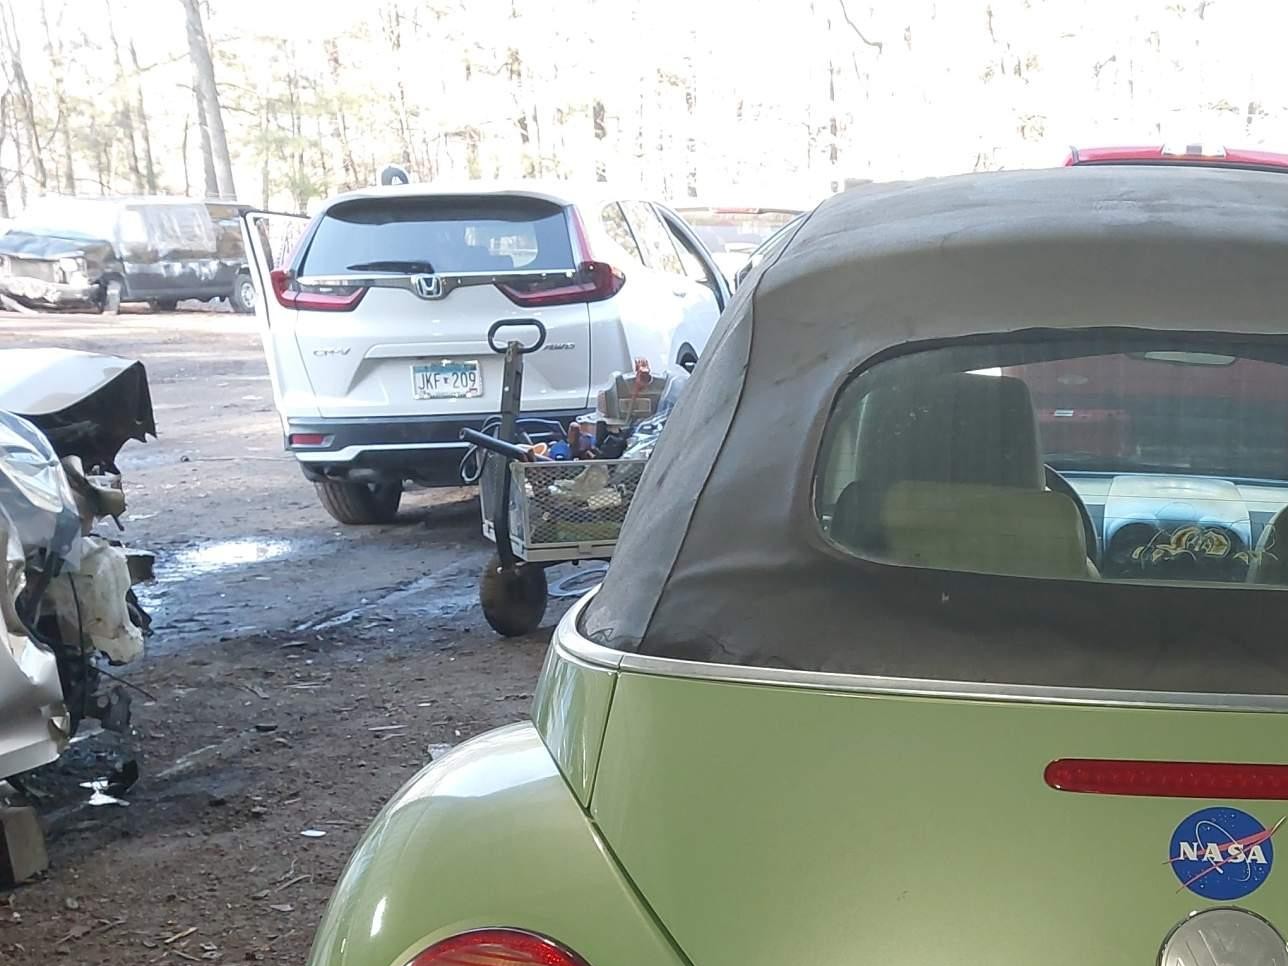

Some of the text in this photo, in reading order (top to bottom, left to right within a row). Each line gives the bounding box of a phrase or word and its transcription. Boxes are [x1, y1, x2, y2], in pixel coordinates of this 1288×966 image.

[418, 371, 477, 391] JKF 209
[1178, 841, 1268, 864] NASA
